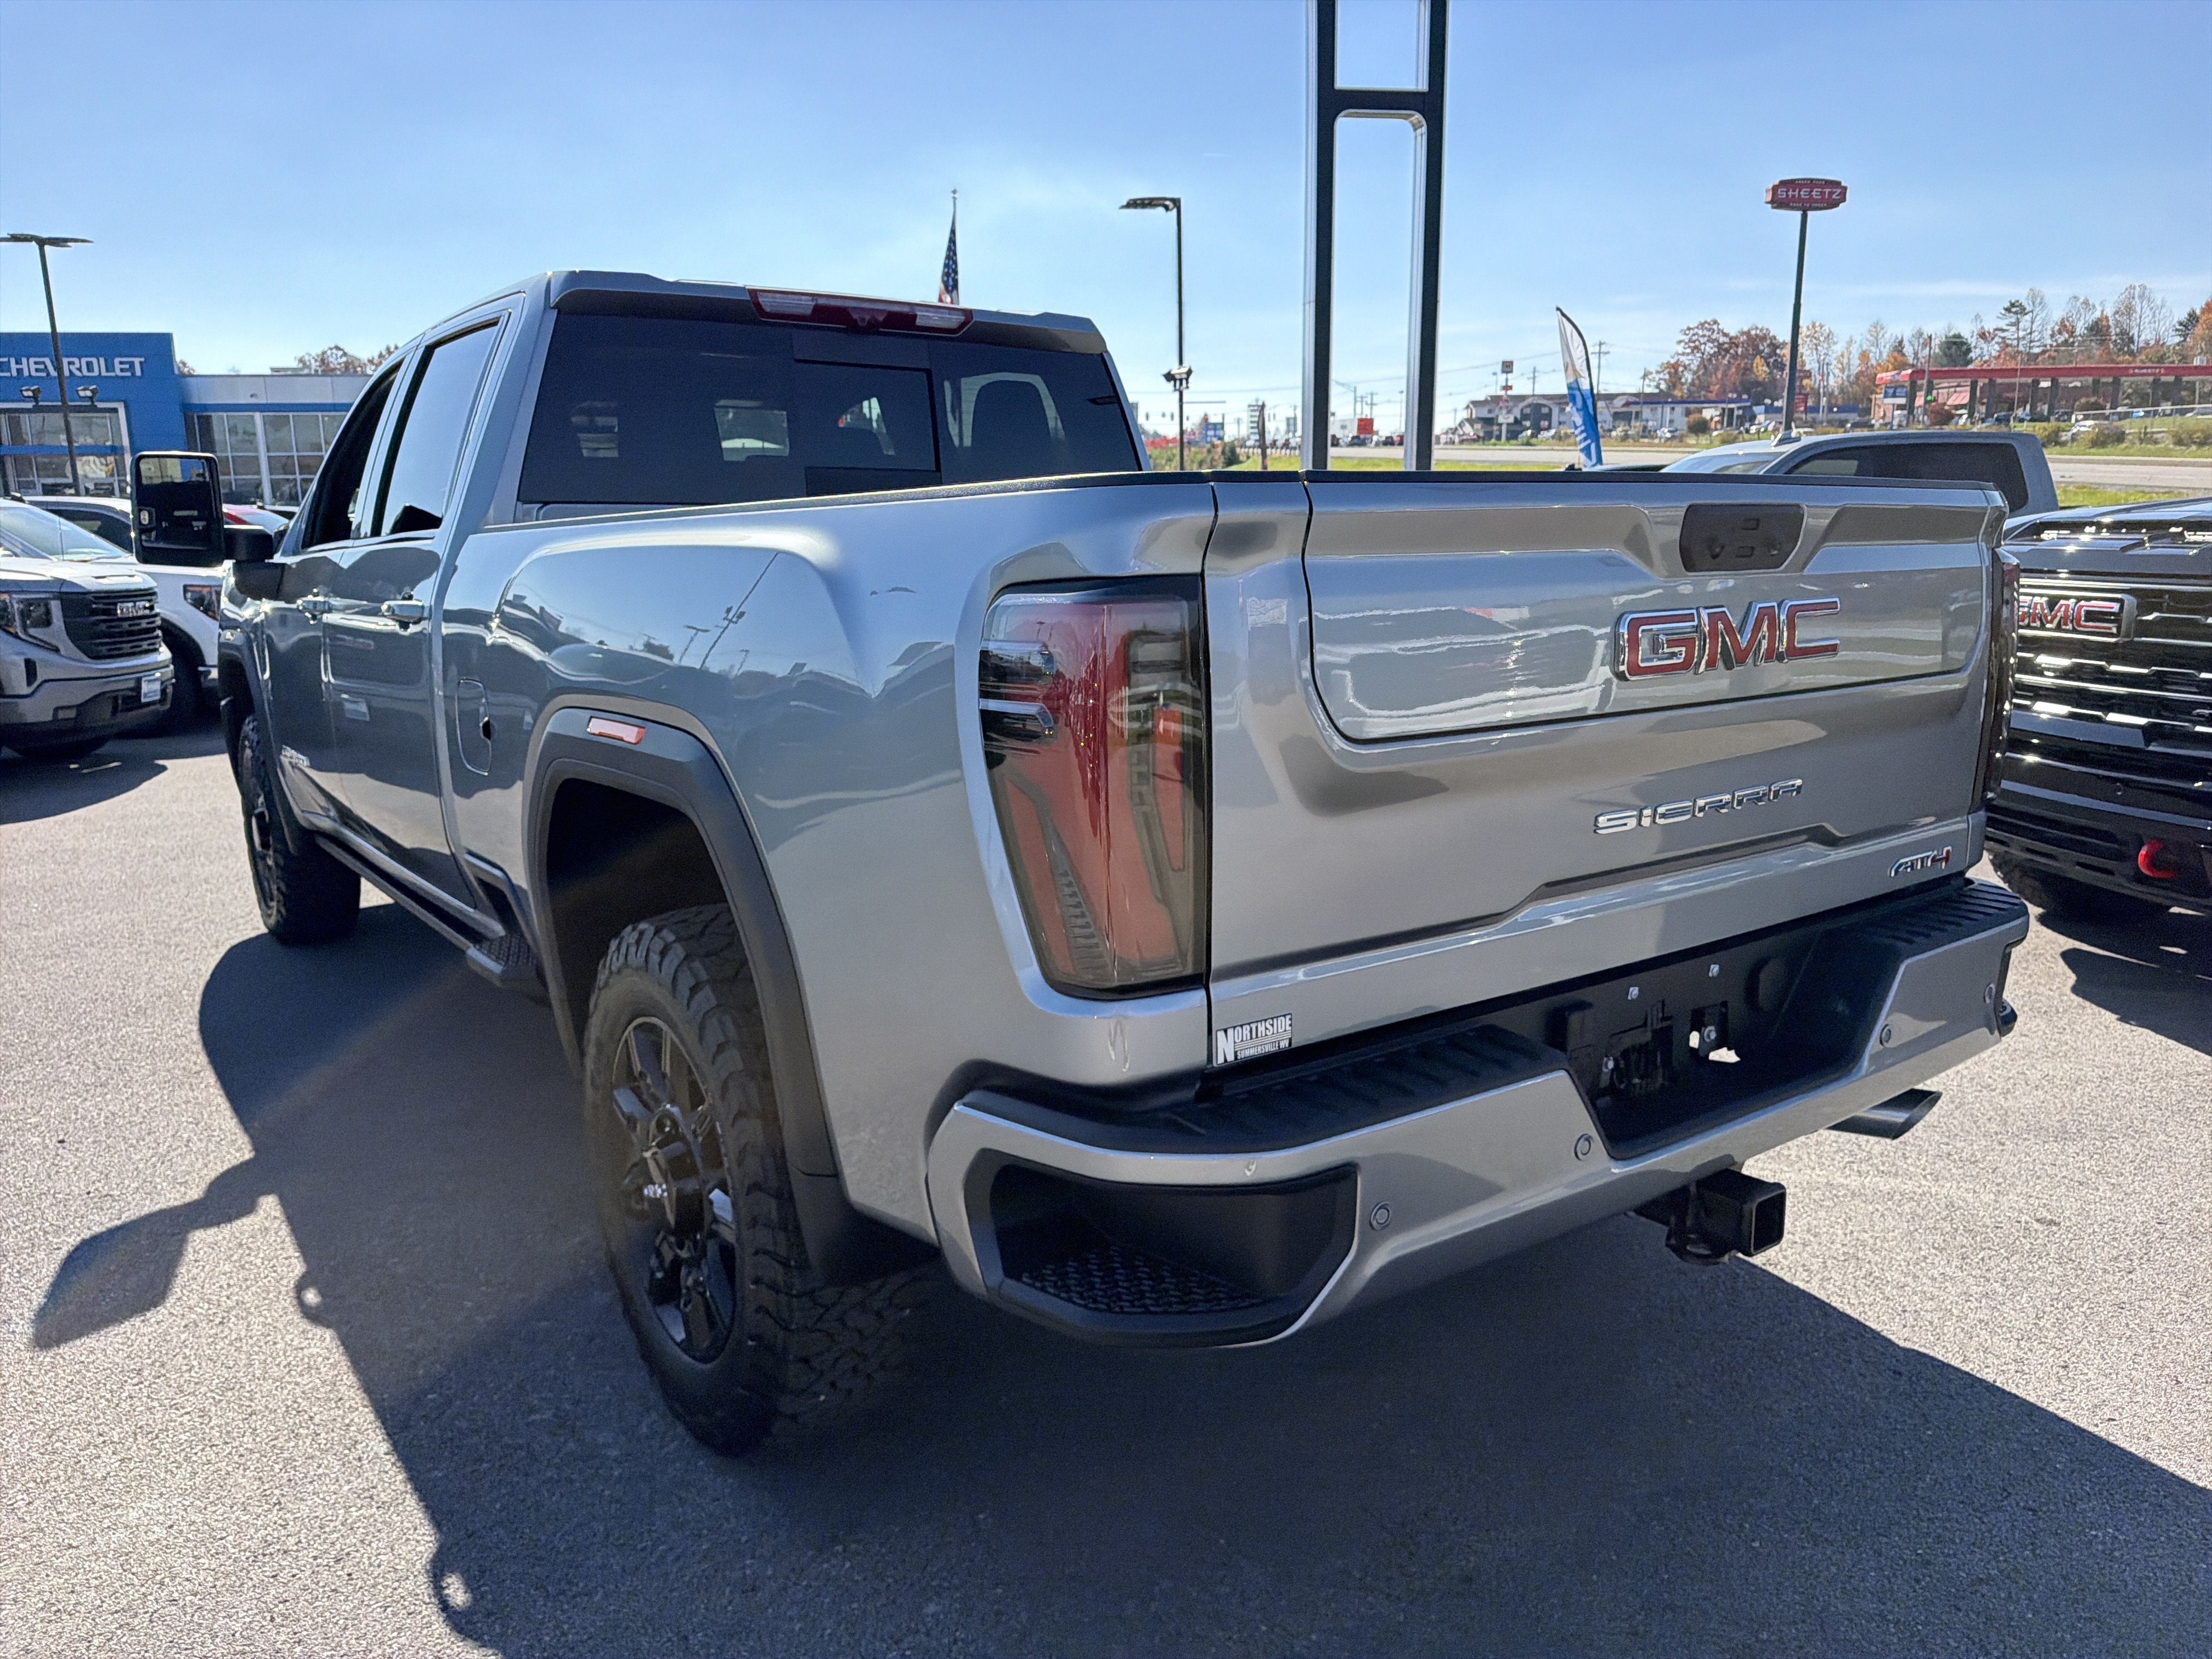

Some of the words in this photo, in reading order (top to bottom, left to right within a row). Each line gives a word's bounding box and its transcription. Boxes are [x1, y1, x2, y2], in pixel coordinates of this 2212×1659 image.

[1778, 188, 1842, 199] SHEETZ
[1611, 597, 1841, 681] GMC
[1593, 778, 1803, 834] SIERRA
[1888, 846, 1952, 877] AT4
[1217, 1014, 1292, 1065] NORTHSIDE
[1237, 1041, 1279, 1059] SUMMERSVILLE
[1279, 1039, 1289, 1049] WV
